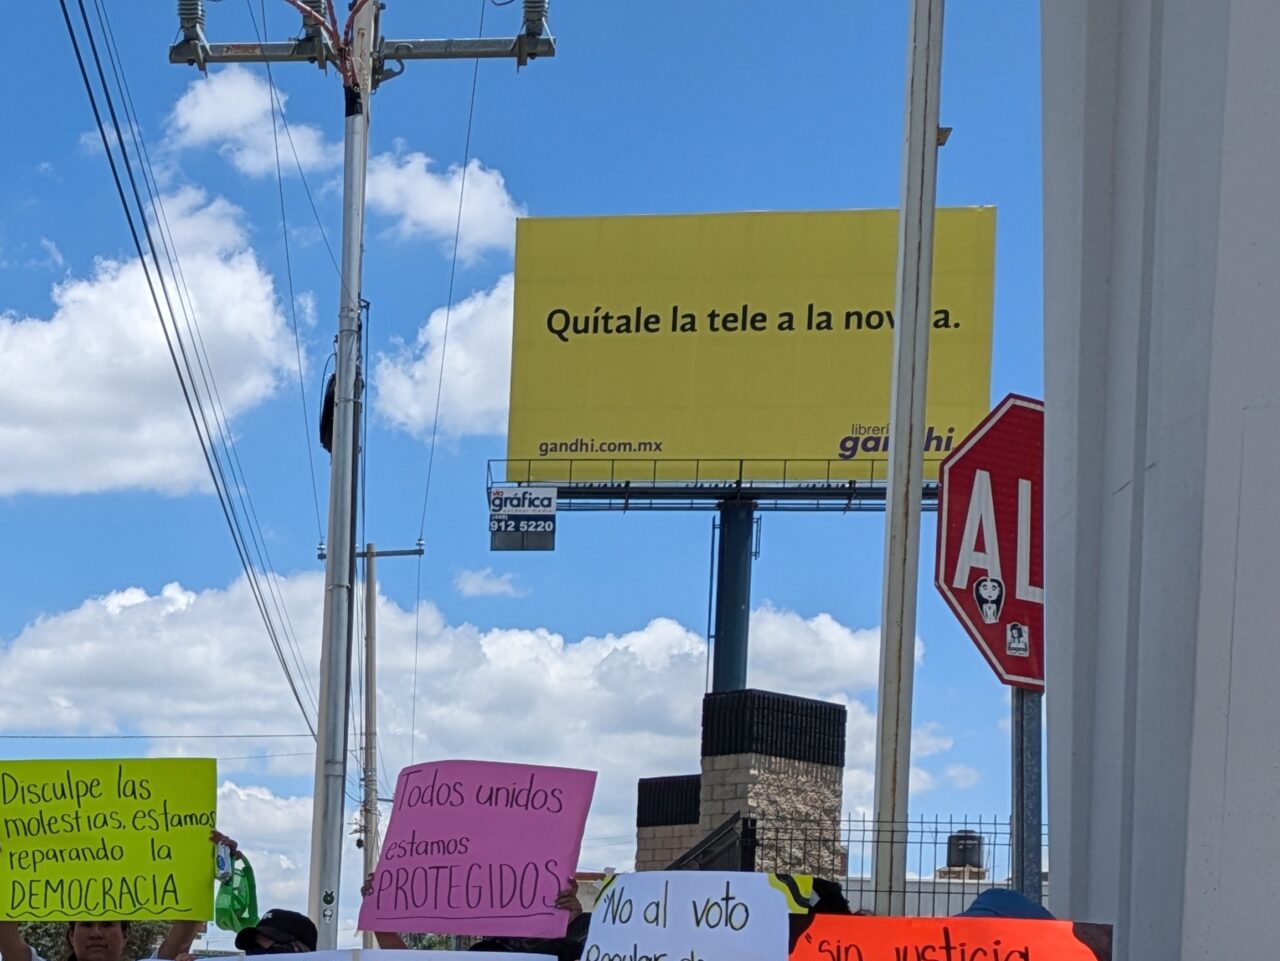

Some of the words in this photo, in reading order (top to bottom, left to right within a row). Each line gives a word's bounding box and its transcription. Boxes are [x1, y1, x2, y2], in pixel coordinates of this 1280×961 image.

[547, 305, 661, 342] Quítale
[671, 305, 696, 333] la
[708, 304, 767, 332] tele
[778, 311, 795, 331] a
[807, 303, 833, 331] la
[844, 309, 960, 330] nova.
[538, 437, 663, 456] gandhi.com.mx
[838, 426, 955, 460] gahi
[851, 424, 890, 435] librerí
[491, 491, 553, 512] gráfica
[490, 521, 515, 532] 912
[519, 521, 554, 532] 5220
[952, 469, 1044, 604] AL
[1, 769, 102, 808] Disculpe
[117, 764, 151, 801] las
[398, 768, 465, 812] Todos
[475, 773, 563, 814] unidos
[131, 799, 216, 832] estamos
[9, 838, 124, 873] reparando
[150, 838, 172, 862] la
[385, 830, 470, 861] estamos
[10, 873, 180, 912] DEMOCRACIA
[376, 859, 561, 911] PROTEGIDOS
[644, 880, 668, 928] al
[693, 880, 749, 931] voto
